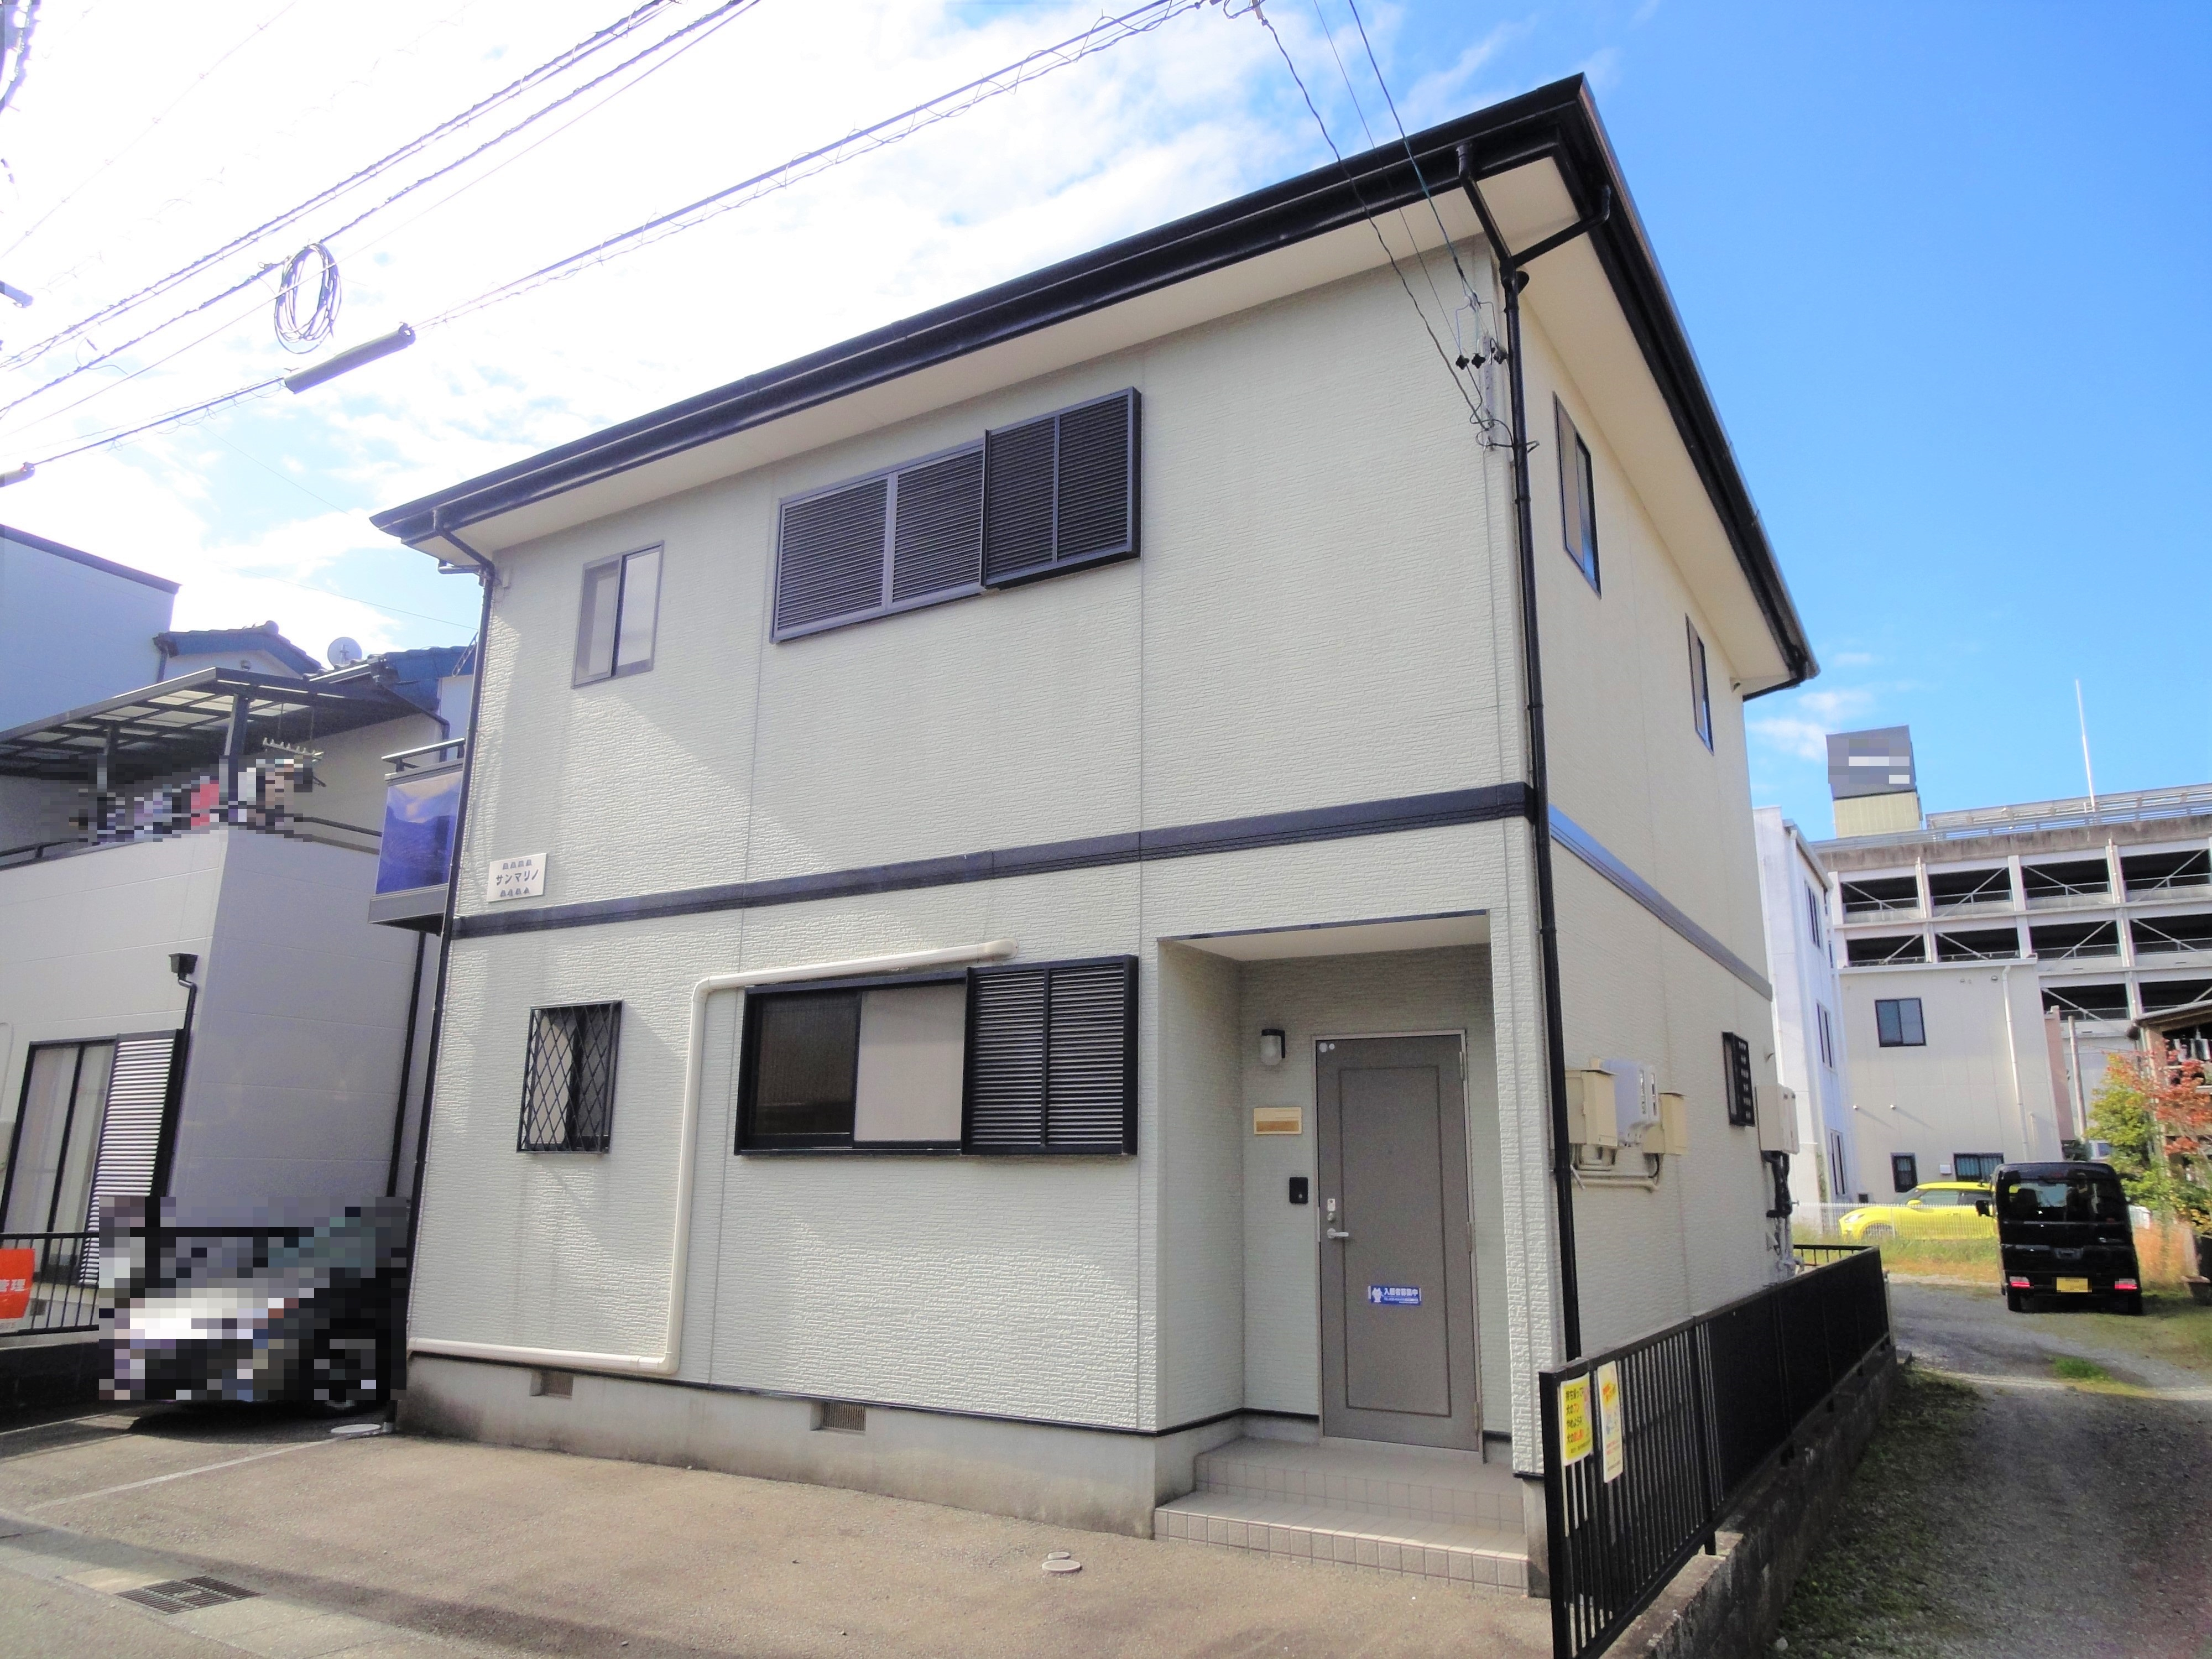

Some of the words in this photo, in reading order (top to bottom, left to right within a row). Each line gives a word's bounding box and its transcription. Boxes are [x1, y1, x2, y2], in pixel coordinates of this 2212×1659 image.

[496, 869, 539, 886] サンマリノ
